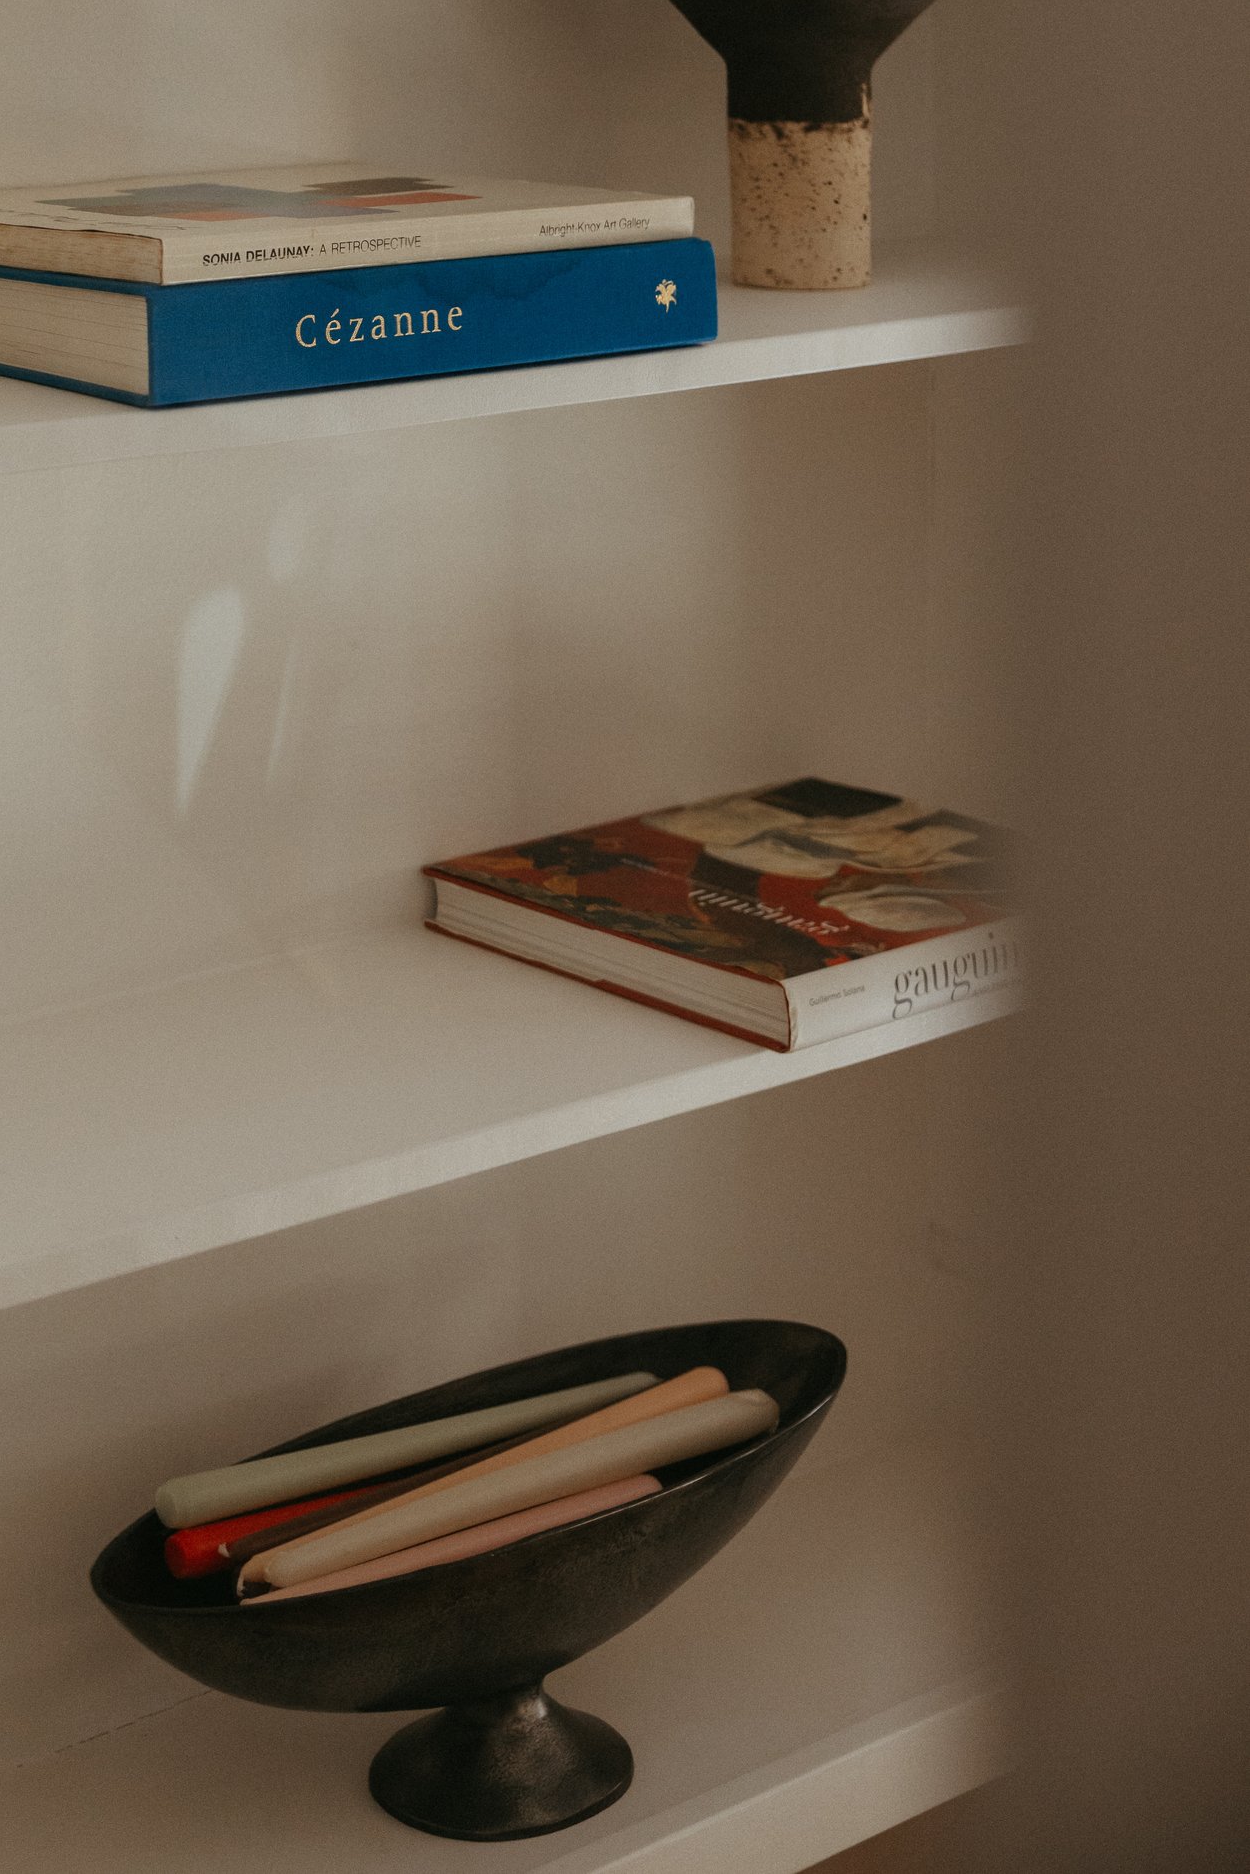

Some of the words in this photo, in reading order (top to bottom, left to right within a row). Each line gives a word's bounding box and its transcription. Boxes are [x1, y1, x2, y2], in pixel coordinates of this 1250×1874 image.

[603, 219, 617, 231] Art
[618, 217, 650, 230] Gallery
[202, 251, 241, 267] SONIA
[246, 245, 314, 262] DELAUNAY:
[319, 244, 327, 256] A
[331, 235, 422, 255] RETROSPECTIVE
[295, 306, 463, 348] Cézanne
[892, 932, 1019, 1020] gauguin
